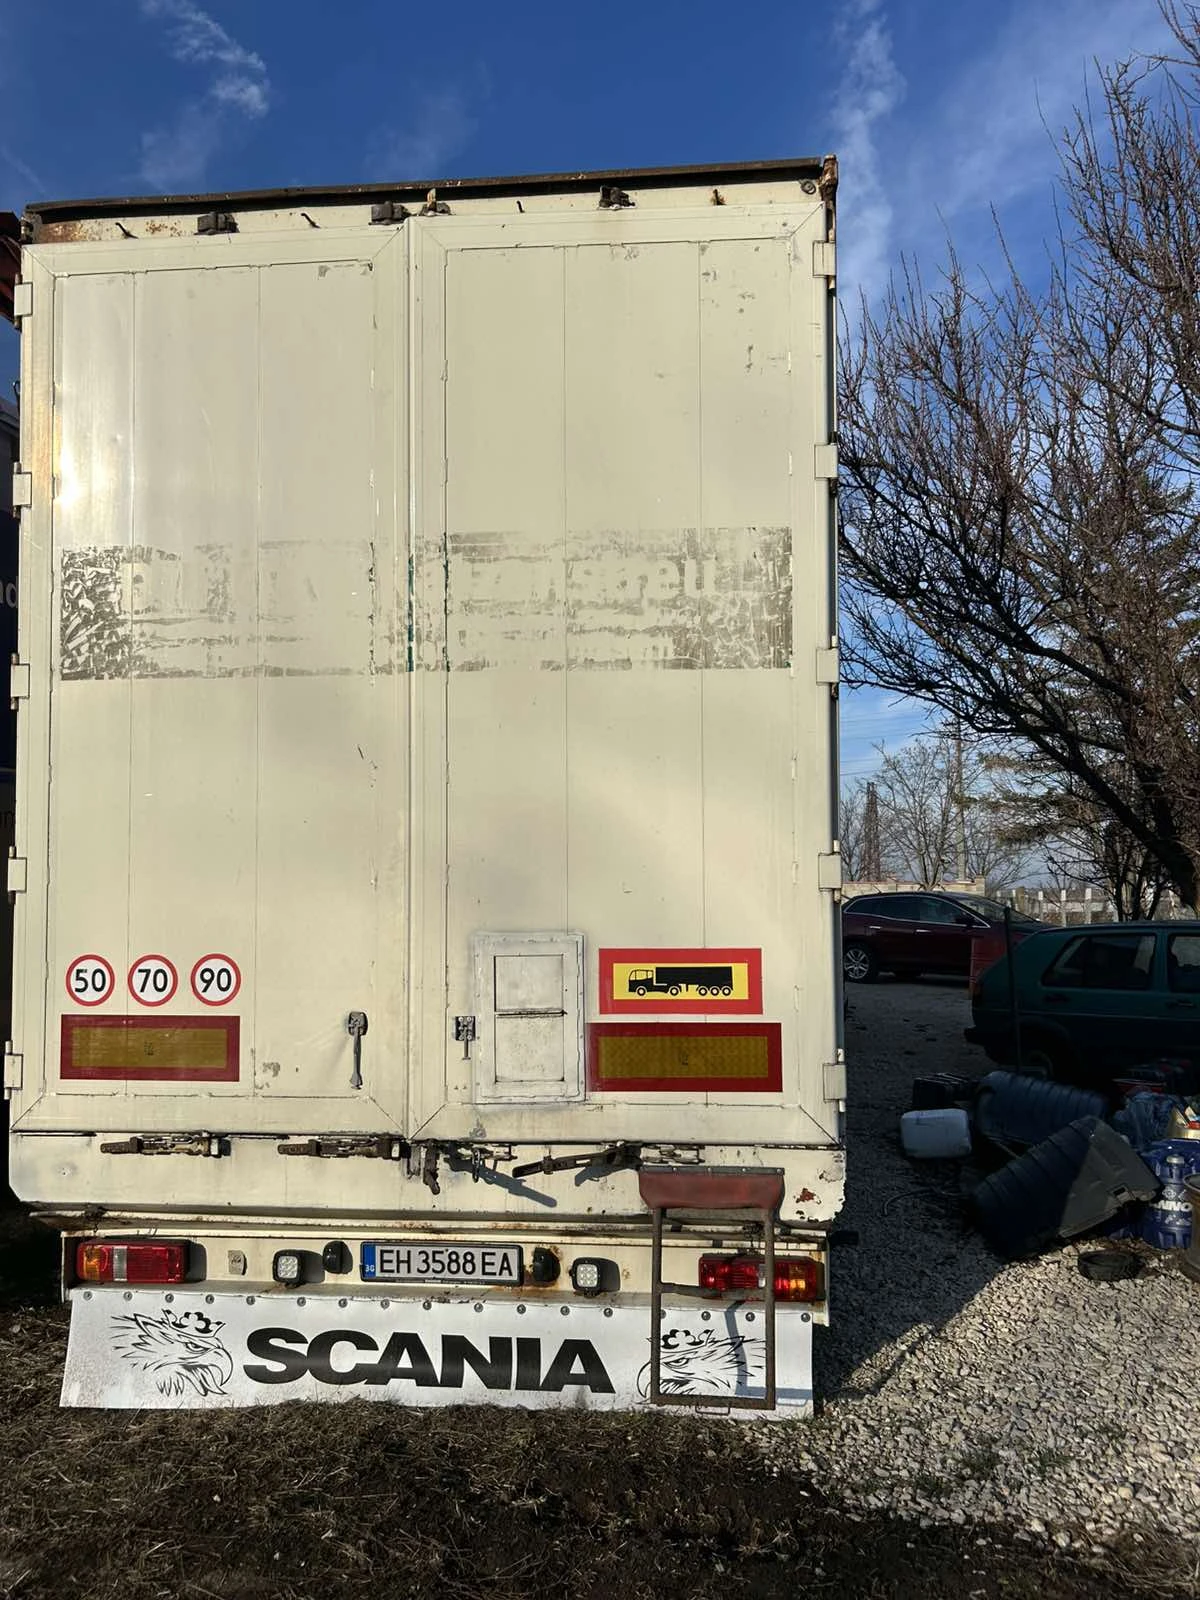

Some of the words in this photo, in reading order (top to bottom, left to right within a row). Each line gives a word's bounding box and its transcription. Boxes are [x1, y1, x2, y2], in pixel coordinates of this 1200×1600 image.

[74, 968, 107, 993] 50
[137, 968, 168, 993] 70
[199, 967, 232, 993] 90
[380, 1249, 412, 1274] EH
[416, 1249, 476, 1275] 3588
[481, 1251, 513, 1277] EA
[243, 1327, 616, 1394] SCANIA
